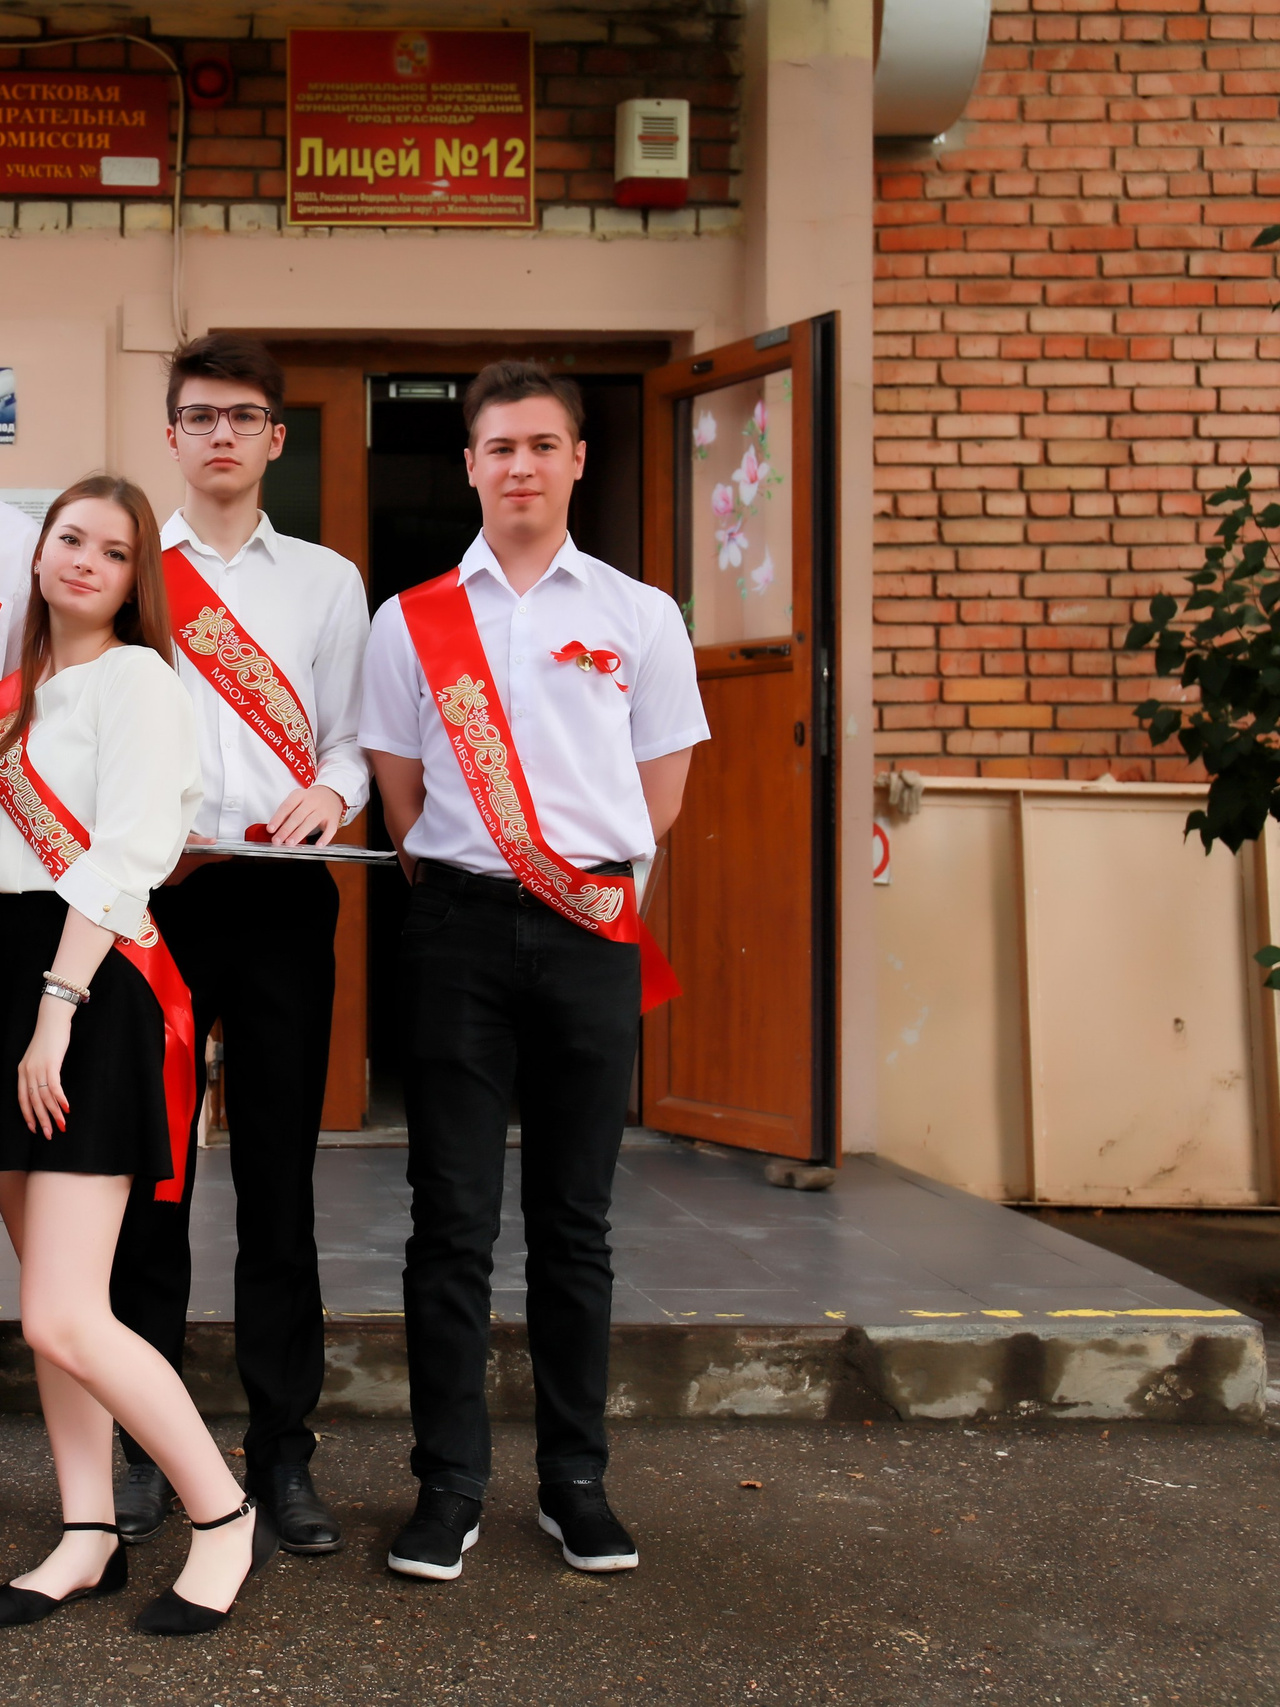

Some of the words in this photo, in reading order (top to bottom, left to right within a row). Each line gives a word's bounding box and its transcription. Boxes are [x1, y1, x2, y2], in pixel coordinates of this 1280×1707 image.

[295, 104, 422, 114] МУНИЦИПАЛЬНОГО
[426, 104, 524, 114] ОБРАЗОВАНИЯ
[347, 115, 393, 124] ГОРОД
[395, 115, 475, 124] КРАСНОДАР
[6, 163, 73, 179] УЧАСТКА
[296, 137, 421, 185] Лицей
[434, 137, 526, 178] №12
[210, 667, 250, 706] МБОУ
[246, 709, 283, 747] лицей
[281, 745, 307, 776] №12
[0, 794, 29, 837] лицей
[30, 836, 54, 873] №12
[452, 735, 478, 781] МБОУ
[472, 786, 498, 832] лицей
[495, 835, 521, 870] №12
[520, 871, 599, 930] г.Краснодар
[464, 719, 573, 894] Выпускник
[561, 884, 625, 923] 2020
